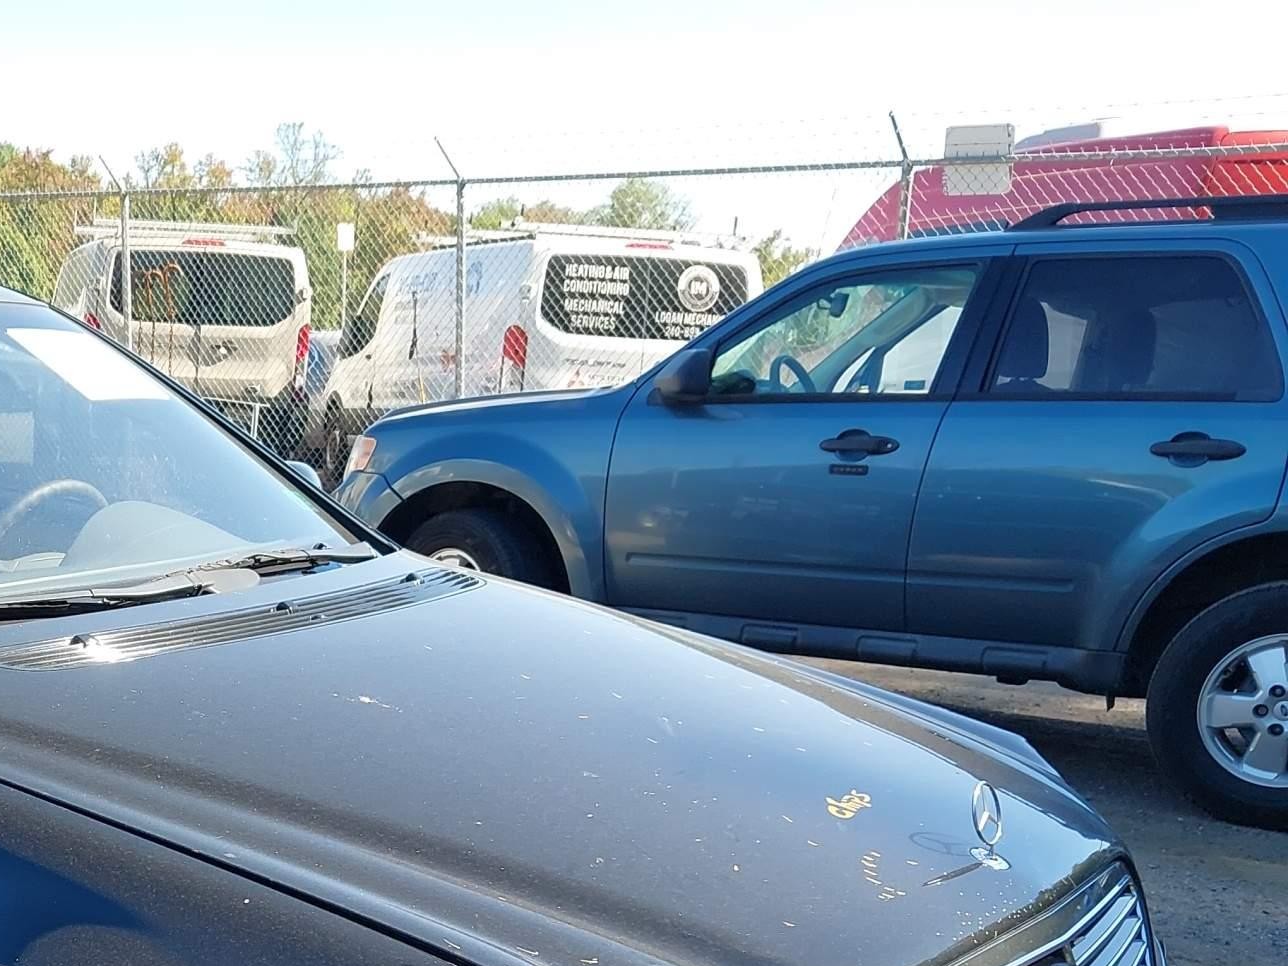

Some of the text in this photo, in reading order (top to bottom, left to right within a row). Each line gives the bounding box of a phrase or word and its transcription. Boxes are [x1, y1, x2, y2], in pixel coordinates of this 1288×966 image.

[564, 280, 630, 296] CONDITIONING
[564, 298, 624, 314] MECHANICAL
[570, 314, 616, 330] SERVICES
